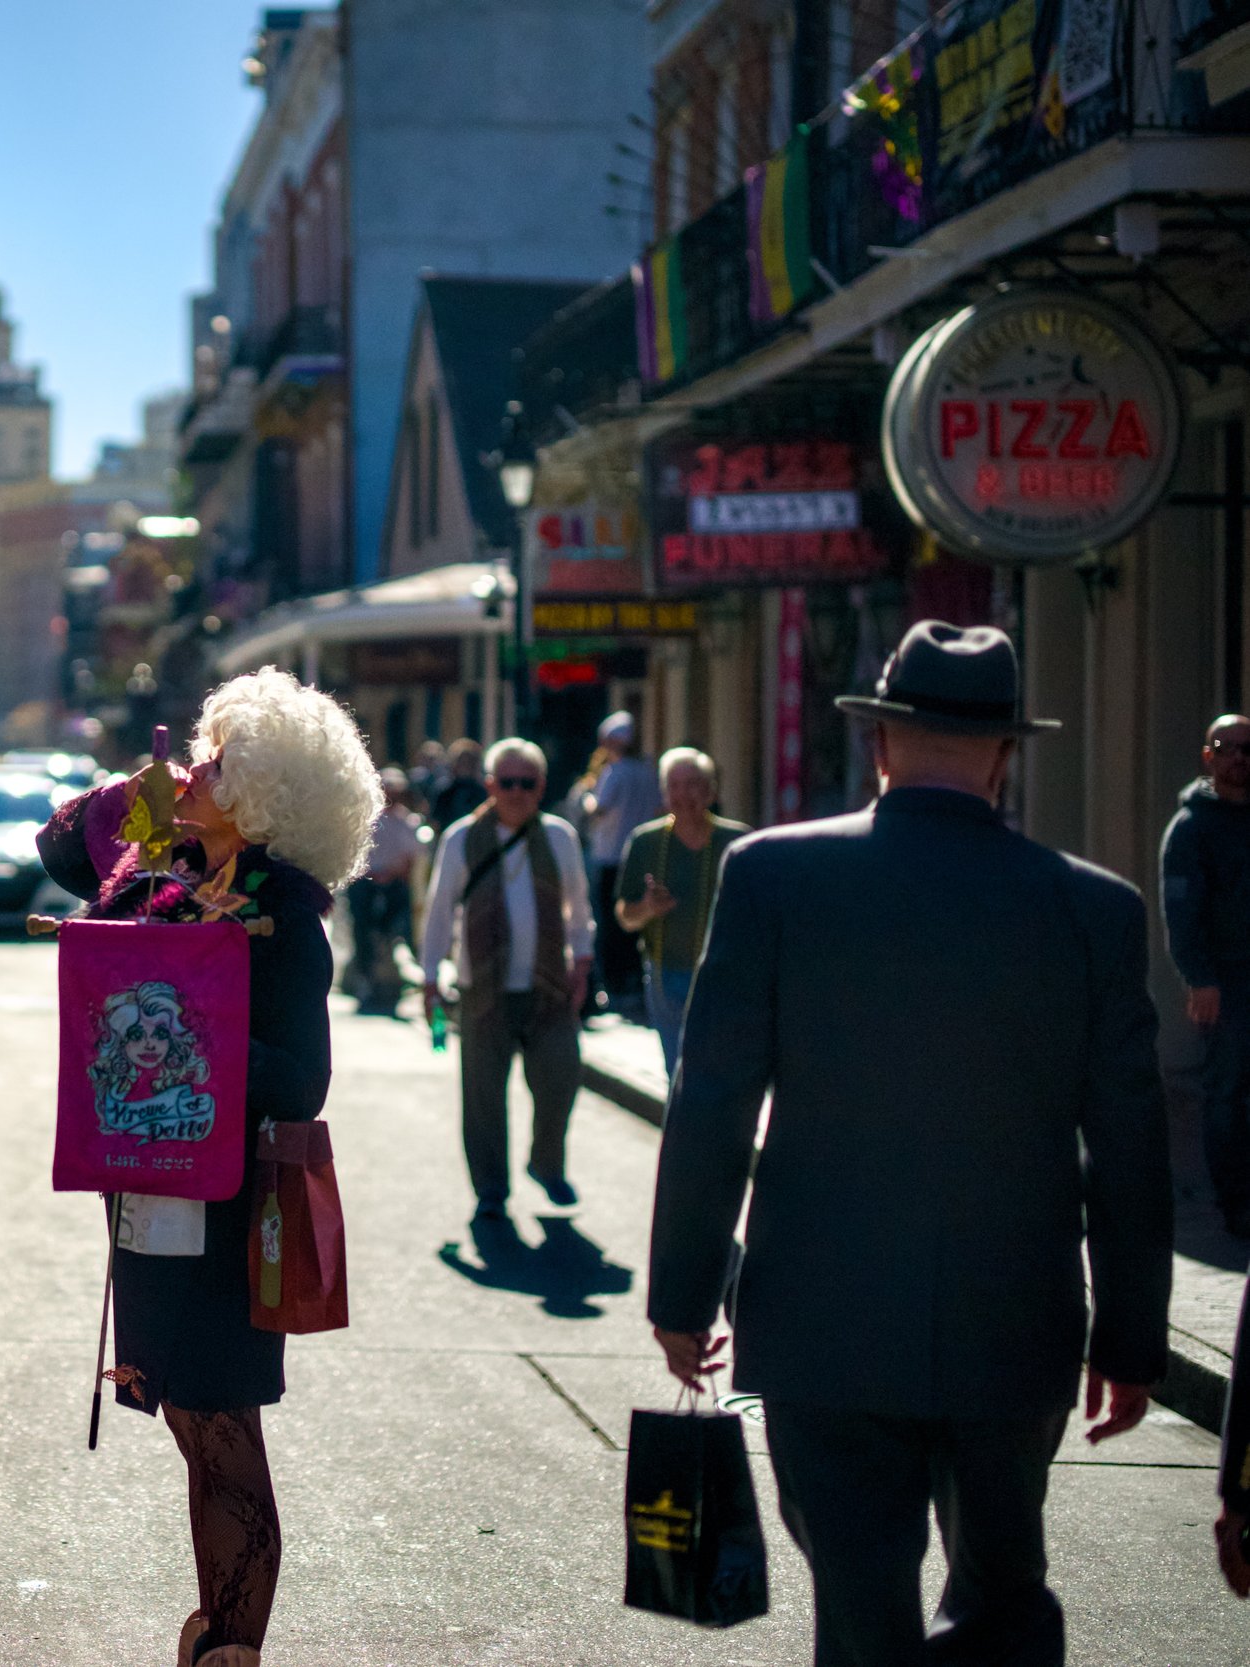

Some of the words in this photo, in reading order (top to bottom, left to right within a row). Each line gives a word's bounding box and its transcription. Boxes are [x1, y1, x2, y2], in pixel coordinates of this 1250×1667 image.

[941, 400, 1149, 459] PIZZA
[1018, 463, 1116, 499] BEER
[109, 1102, 174, 1125] Krewe
[182, 1096, 207, 1111] of
[149, 1118, 209, 1142] Dolly
[151, 1156, 195, 1170] 2020
